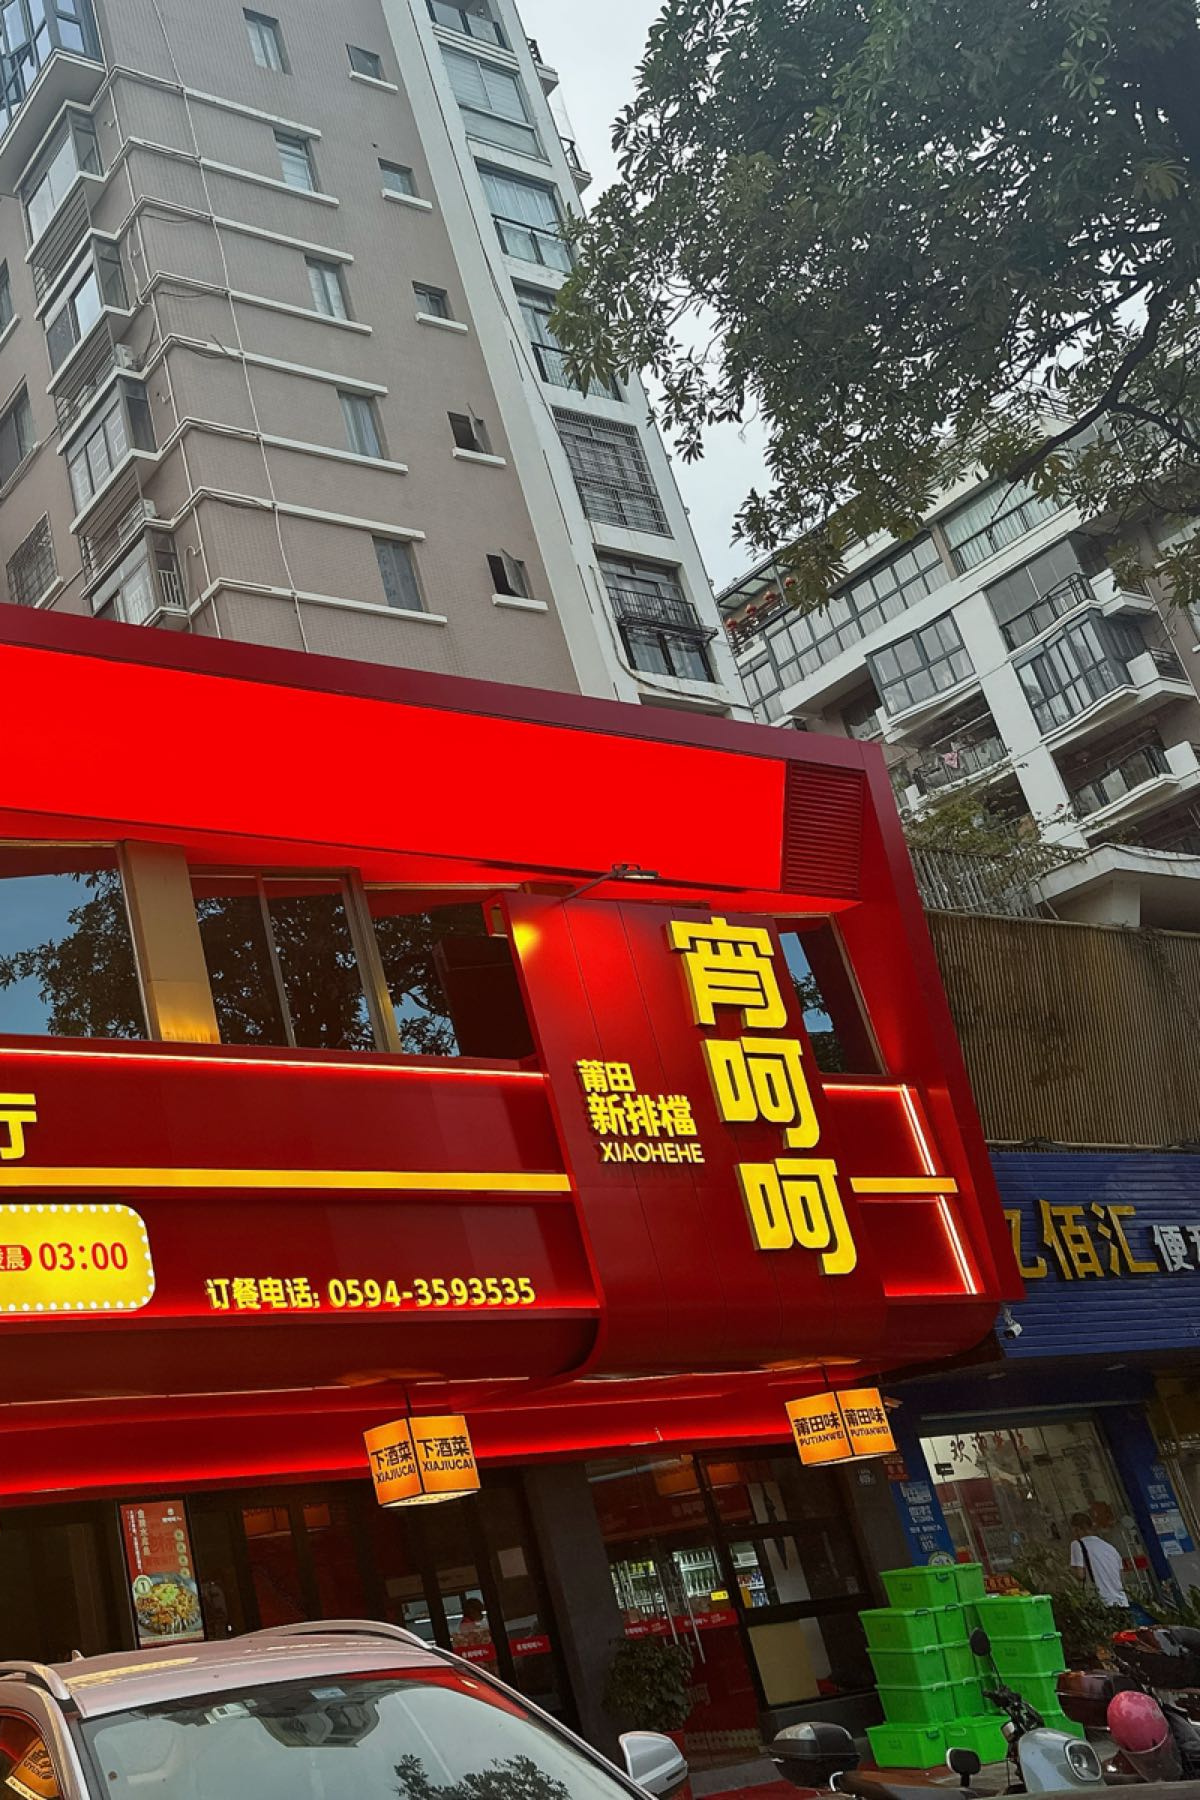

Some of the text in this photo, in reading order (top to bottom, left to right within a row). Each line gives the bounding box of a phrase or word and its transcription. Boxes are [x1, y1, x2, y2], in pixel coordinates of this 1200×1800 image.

[576, 1059, 637, 1093] 莆田
[669, 917, 857, 1275] 宵呵呵
[599, 1141, 706, 1164] XIAOHEHE
[39, 1241, 129, 1271] 03:00
[328, 1277, 536, 1308] 0594-3593535
[793, 1411, 840, 1436] 莆田味
[844, 1406, 886, 1427] 莆田味
[371, 1440, 413, 1470] 下酒菜
[417, 1435, 471, 1459] 下酒菜
[375, 1463, 416, 1483] XIAJIUCAI
[422, 1458, 474, 1472] XIAJIUCAI
